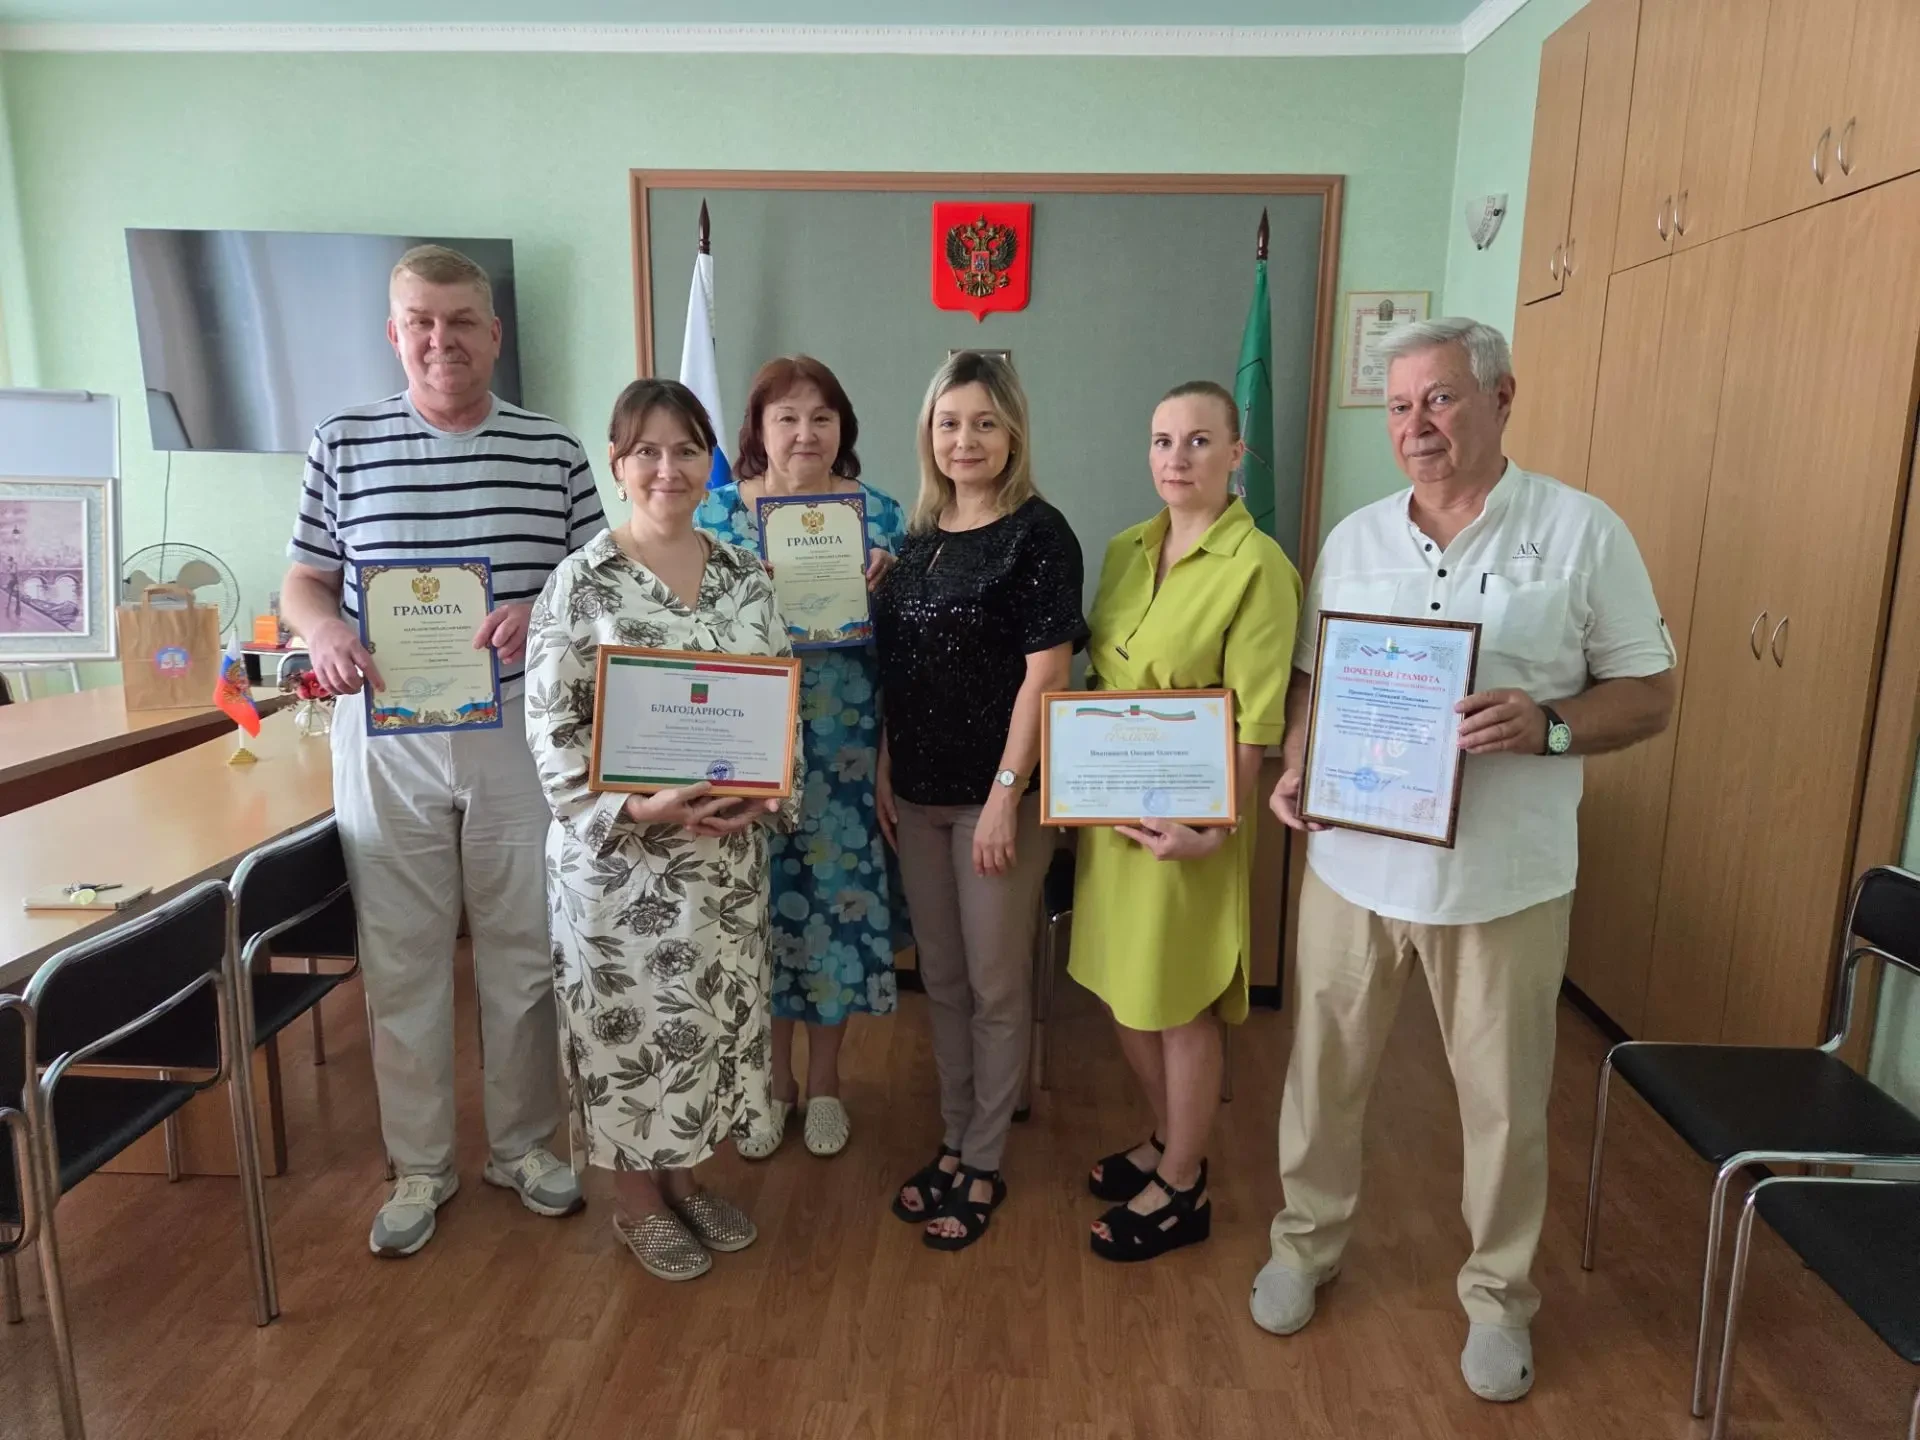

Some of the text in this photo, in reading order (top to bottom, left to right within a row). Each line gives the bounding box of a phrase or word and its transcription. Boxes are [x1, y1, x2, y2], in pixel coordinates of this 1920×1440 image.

[787, 535, 843, 547] ГРАМОТА
[393, 604, 462, 616] ГРАМОТА
[1397, 671, 1440, 684] ГРАМОТА
[651, 704, 745, 718] БЛАГОДАРНОСТЬ
